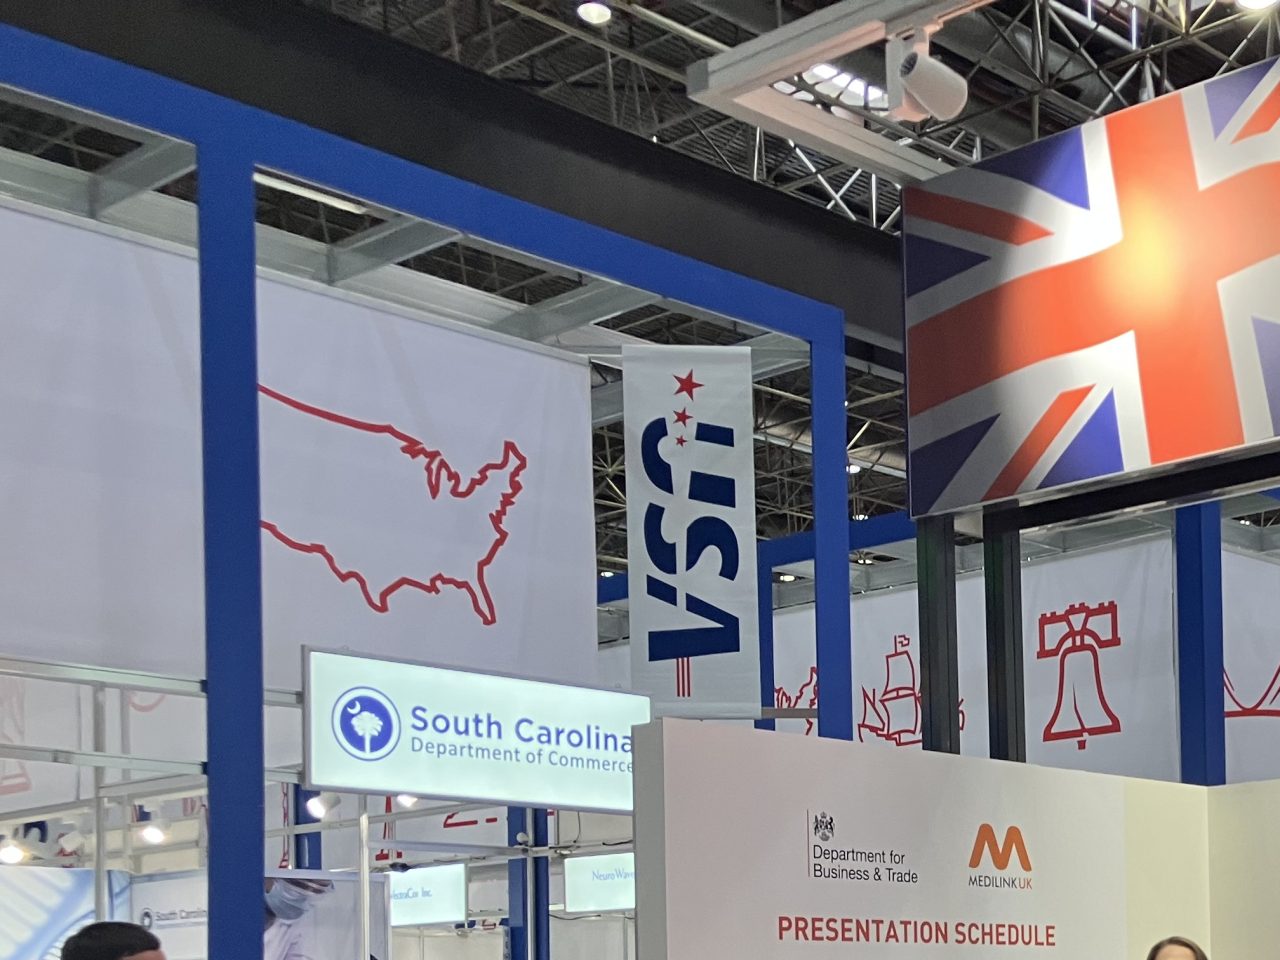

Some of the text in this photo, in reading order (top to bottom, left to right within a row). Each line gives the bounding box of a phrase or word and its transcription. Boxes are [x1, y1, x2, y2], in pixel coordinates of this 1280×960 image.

[411, 705, 632, 753] South Carolina
[411, 737, 520, 763] Department
[526, 749, 543, 764] of
[813, 844, 905, 864] Department for
[813, 862, 918, 884] Business & Trade
[778, 915, 1056, 946] PRESENTATION SCHEDULE
